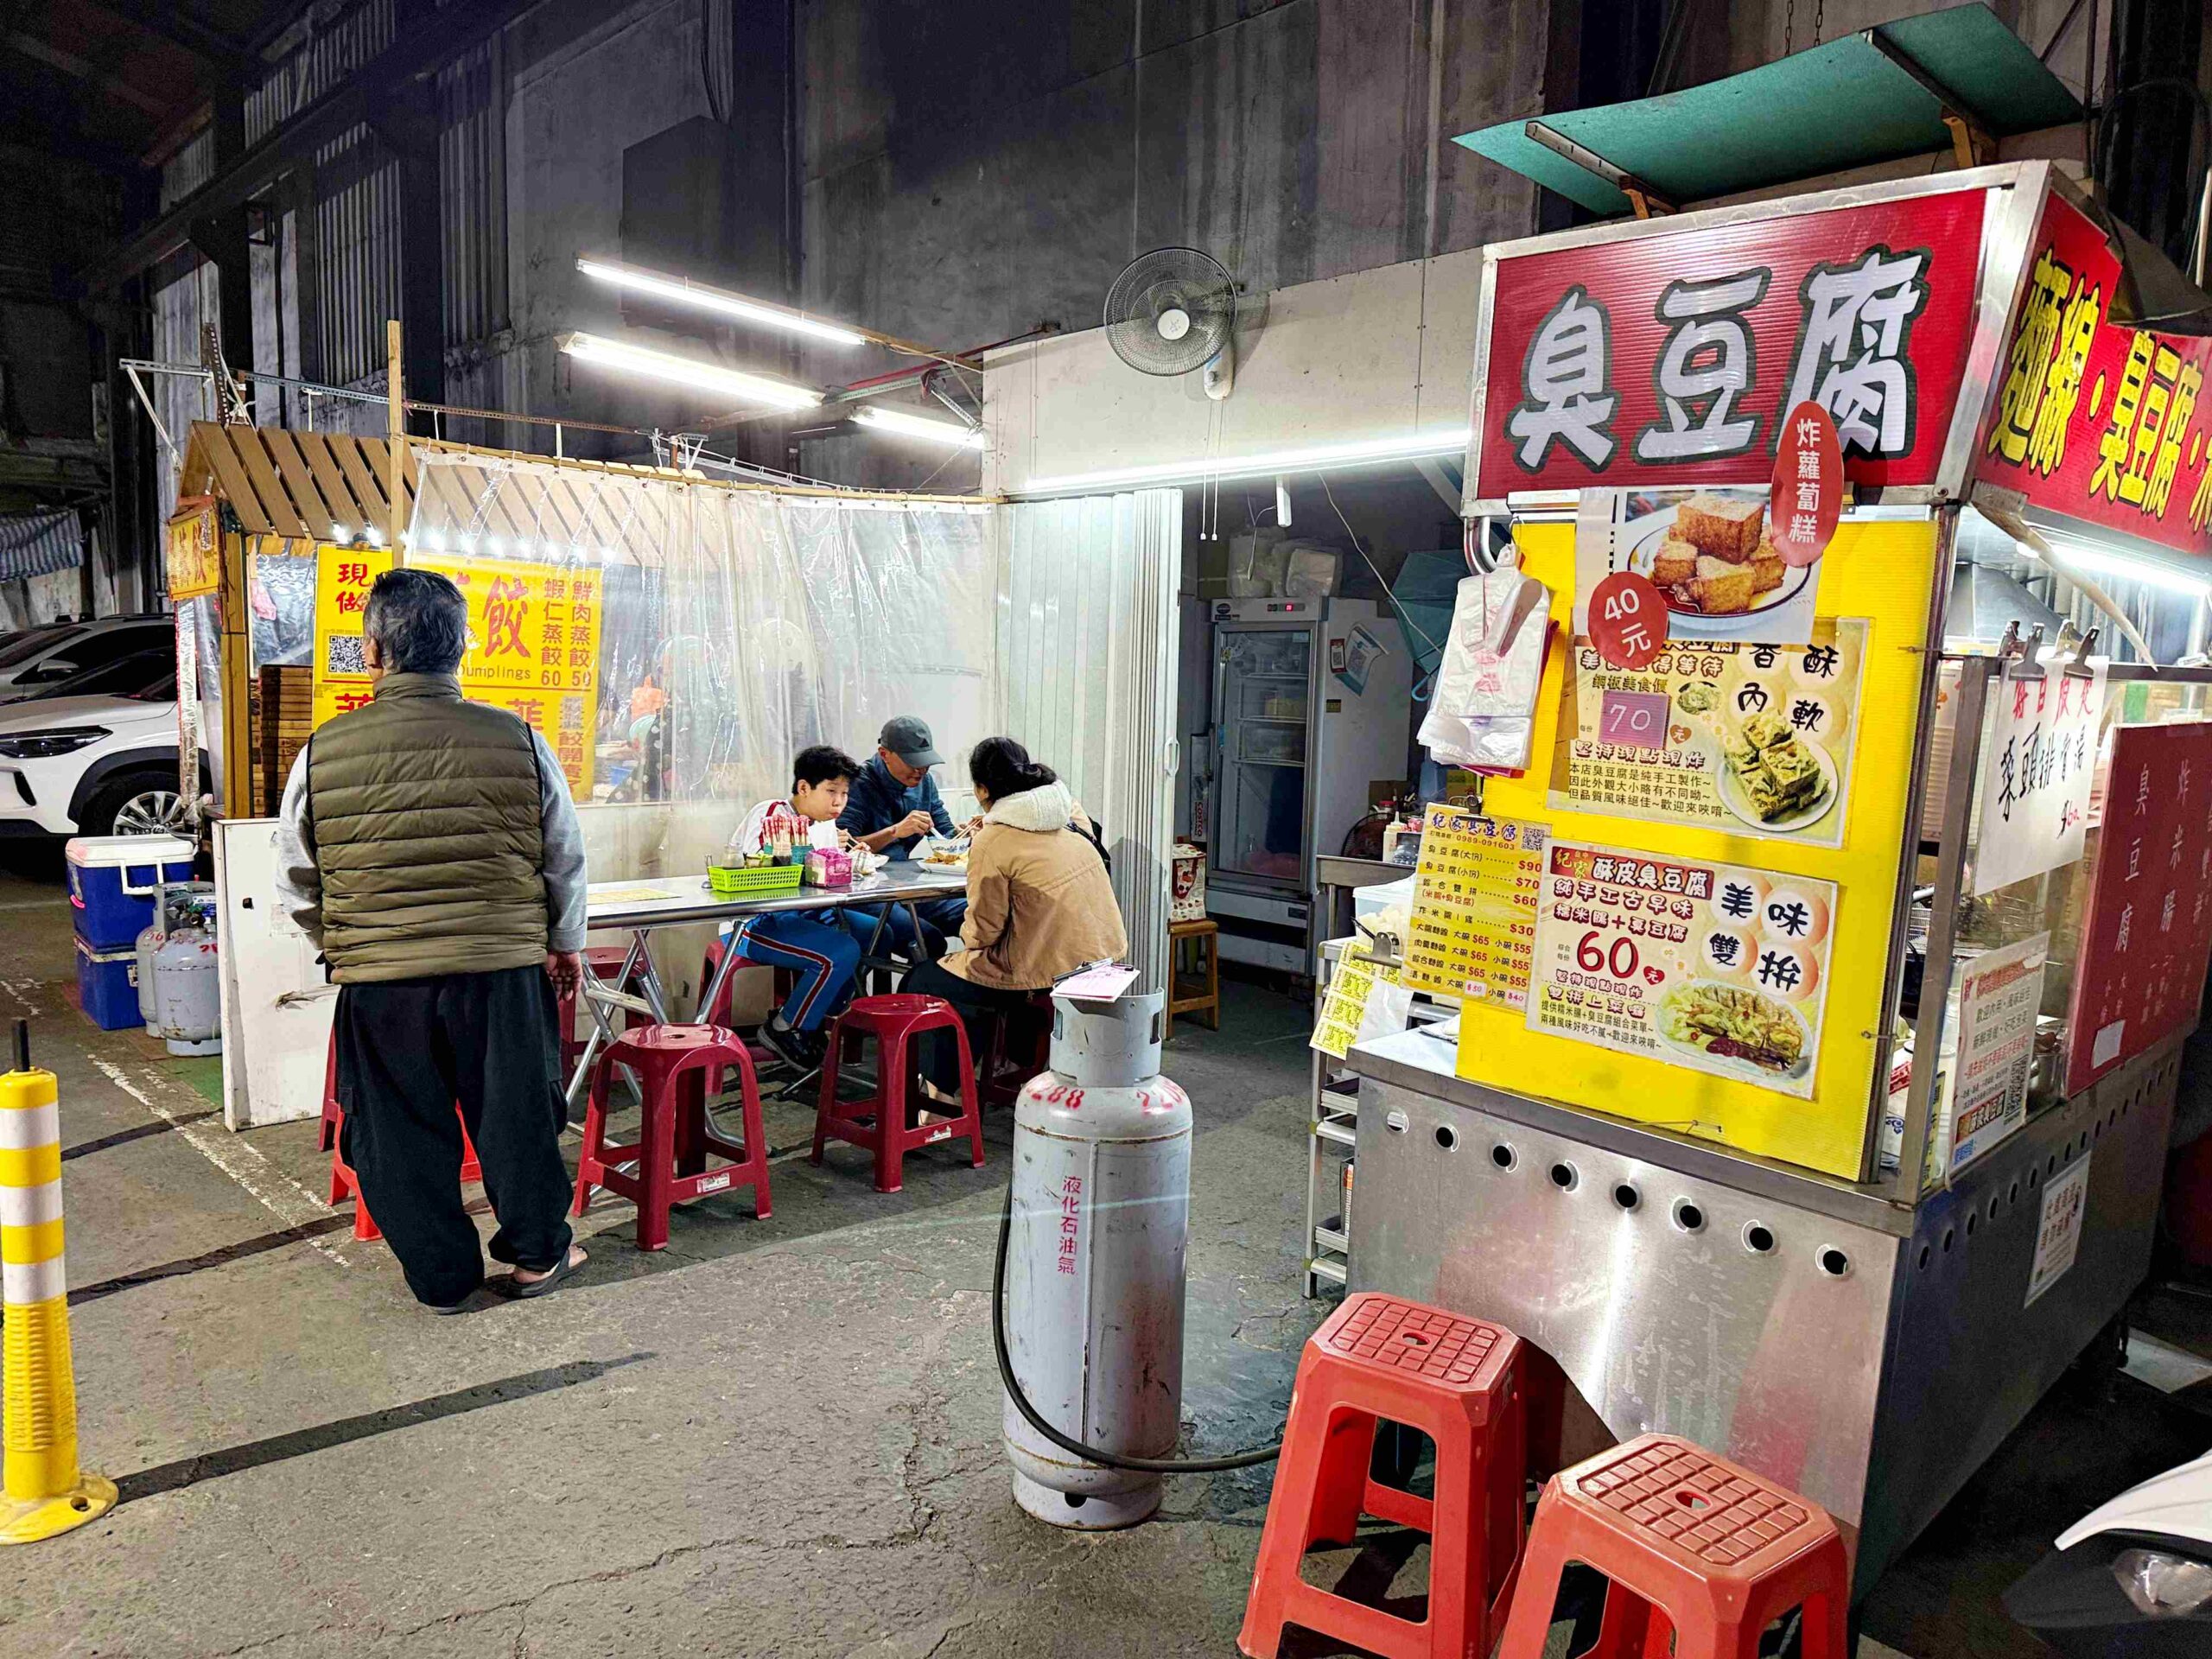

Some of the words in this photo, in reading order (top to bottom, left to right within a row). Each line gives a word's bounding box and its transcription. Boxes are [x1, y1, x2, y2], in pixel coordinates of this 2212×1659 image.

[1505, 243, 1934, 475] 臭豆腐
[1788, 417, 1821, 543] 炸蘿蔔糕
[1603, 586, 1641, 623] 40
[540, 577, 565, 667] 蝦仁蒸餃
[569, 580, 593, 668] 鮮肉蒸餃
[1620, 626, 1652, 659] 元
[1580, 648, 1724, 678] 美得等待
[541, 671, 562, 687] 60
[571, 671, 592, 688] 50
[1610, 702, 1651, 734] 70
[1674, 728, 1686, 741] 元
[1575, 740, 1706, 770] 堅持現點現炸
[1432, 812, 1518, 842] 紀家臭豆腐
[1518, 860, 1542, 873] $90
[1592, 856, 1709, 899] 酥皮臭豆腐
[1516, 877, 1540, 890] $70
[1513, 893, 1538, 907] $60
[1554, 879, 1694, 920] 純手工古早味
[1721, 883, 1809, 937] 美味
[1472, 934, 1490, 945] $65
[1514, 943, 1532, 954] $55
[1510, 924, 1534, 936] $30
[1471, 950, 1487, 962] $65
[1511, 959, 1529, 970] $55
[1577, 931, 1640, 979] 60
[1710, 932, 1802, 993] 雙拼
[1468, 966, 1485, 978] $65
[1510, 976, 1527, 987] $55
[1556, 969, 1643, 999] 堅持現點現炸
[1648, 970, 1659, 983] 元
[1058, 1175, 1082, 1274] 液化石油氣
